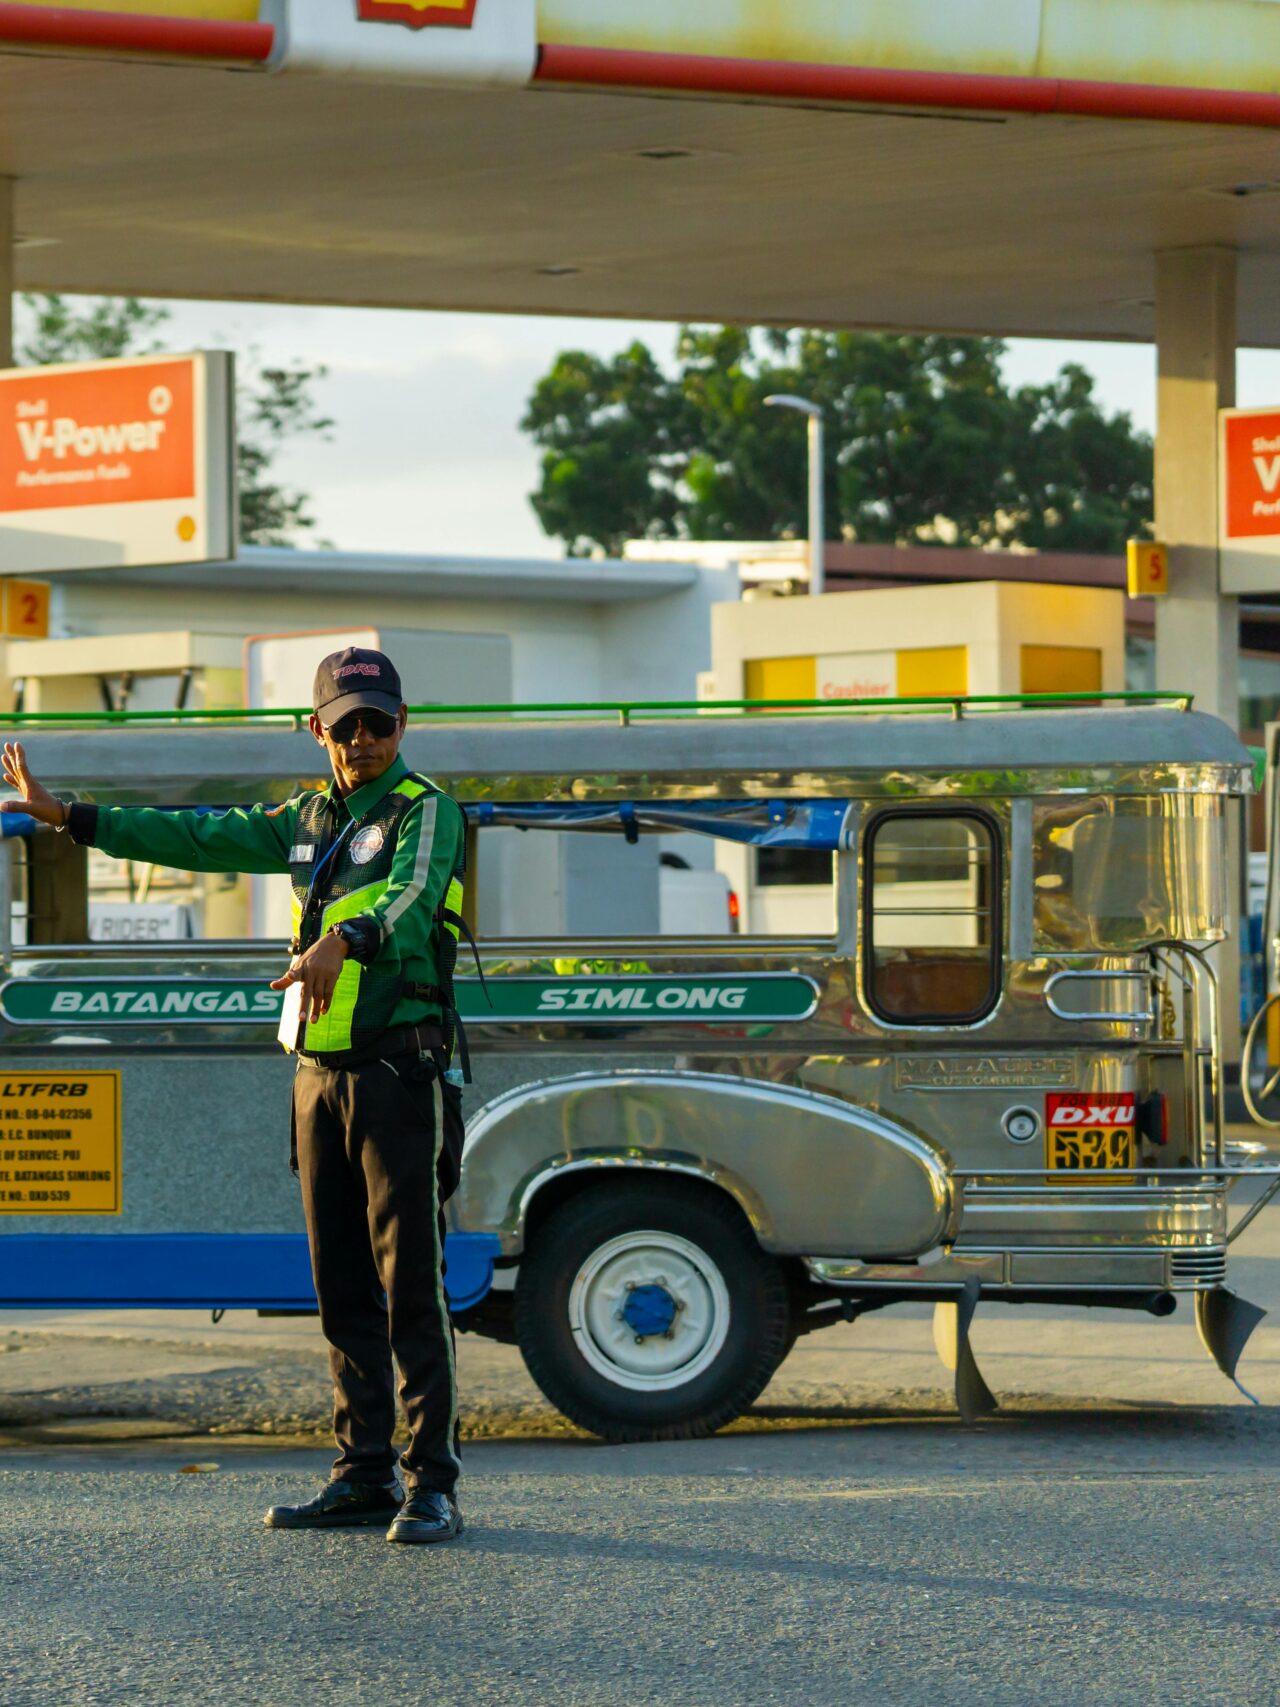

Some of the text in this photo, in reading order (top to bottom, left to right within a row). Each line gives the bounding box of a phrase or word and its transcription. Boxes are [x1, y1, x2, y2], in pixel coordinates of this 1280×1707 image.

[17, 418, 165, 461] V-Power
[1151, 552, 1162, 581] 5
[21, 594, 38, 625] 2
[50, 987, 747, 1013] BATANGAS SIMLONG
[2, 1083, 89, 1098] LTFRB
[1051, 1106, 1135, 1124] DXU
[4, 1150, 15, 1161] OF
[1055, 1129, 1130, 1169] 539
[14, 1170, 65, 1182] BATANGAS
[67, 1170, 111, 1182] SIMLONG
